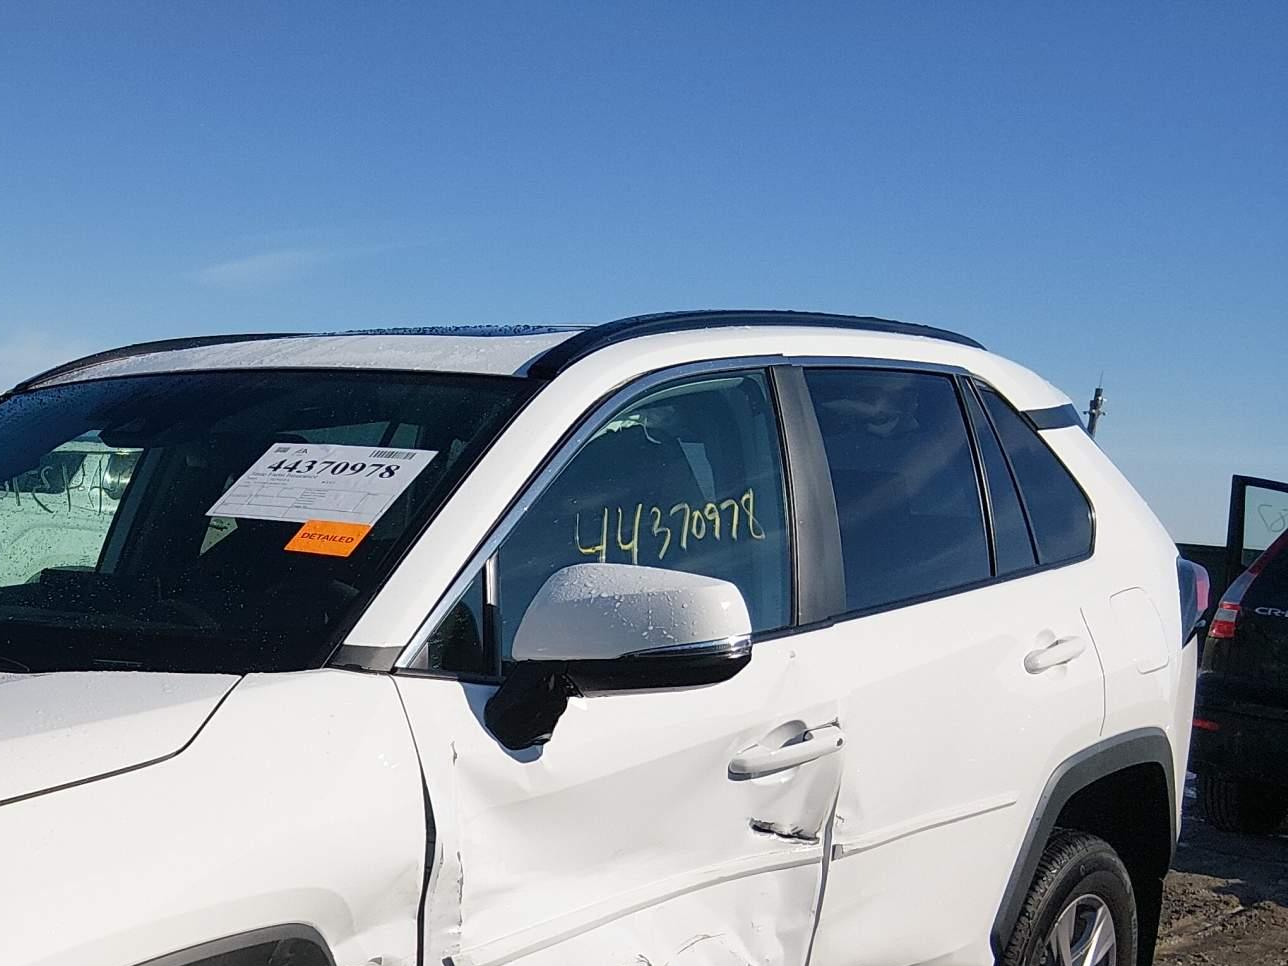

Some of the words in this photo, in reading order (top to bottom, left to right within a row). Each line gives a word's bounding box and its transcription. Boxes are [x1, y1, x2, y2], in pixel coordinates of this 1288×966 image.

[267, 458, 402, 480] 44370978
[300, 530, 355, 545] DETAILED
[575, 487, 766, 566] 44370978
